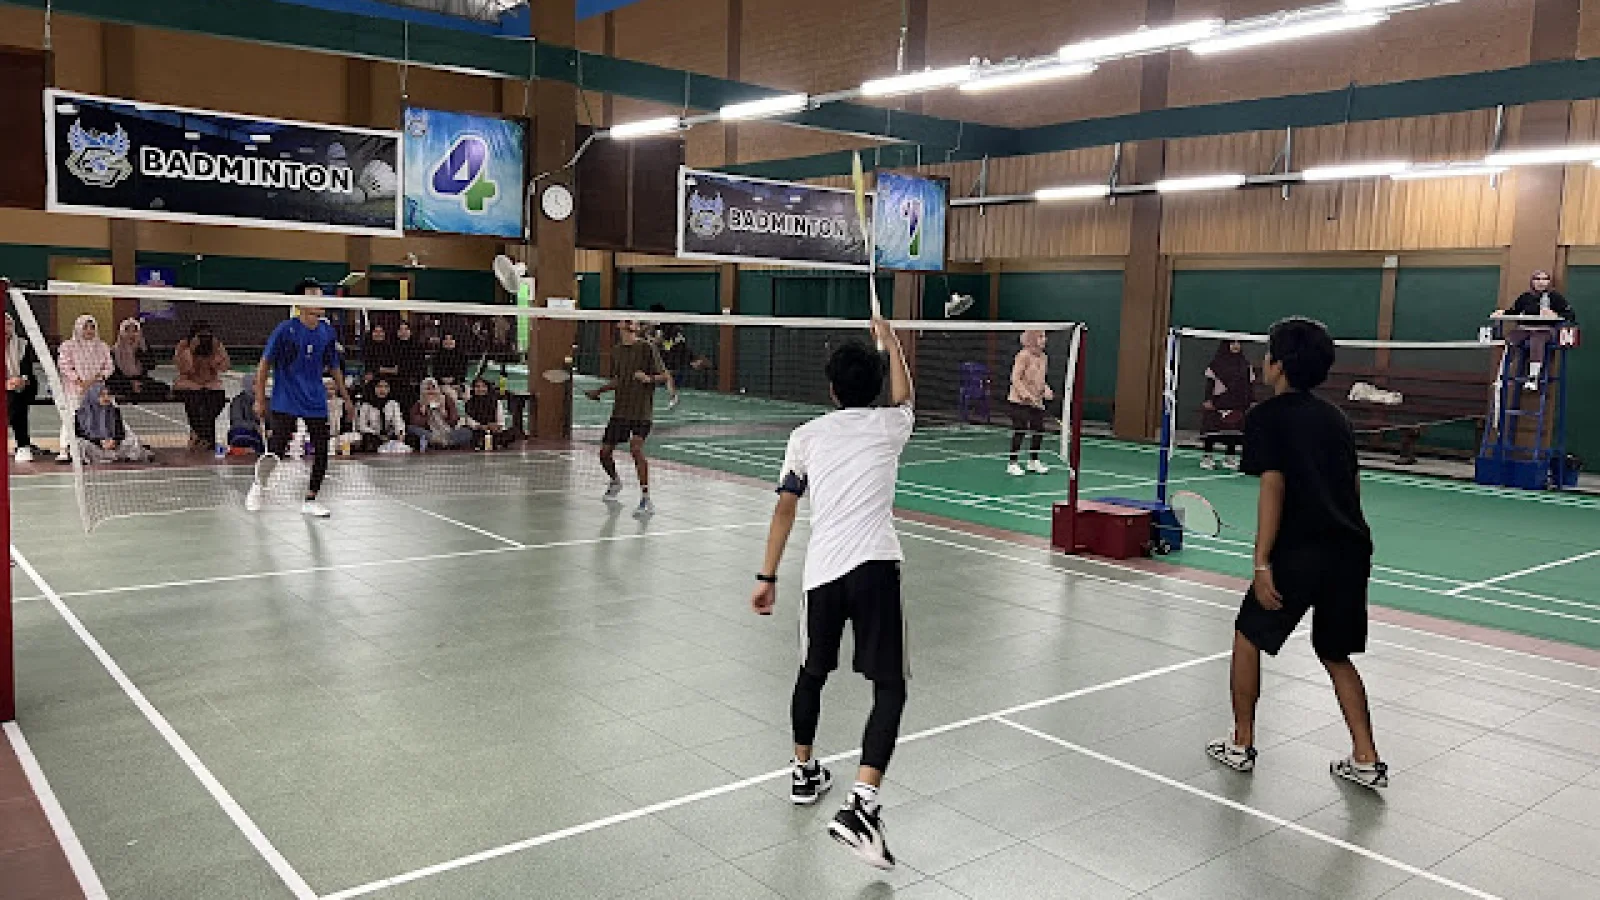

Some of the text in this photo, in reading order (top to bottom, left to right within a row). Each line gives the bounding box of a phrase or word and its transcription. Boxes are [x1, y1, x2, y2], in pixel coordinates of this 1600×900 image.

[140, 146, 354, 194] BADMINTON
[432, 135, 498, 215] 4
[729, 206, 846, 239] BADMINTON
